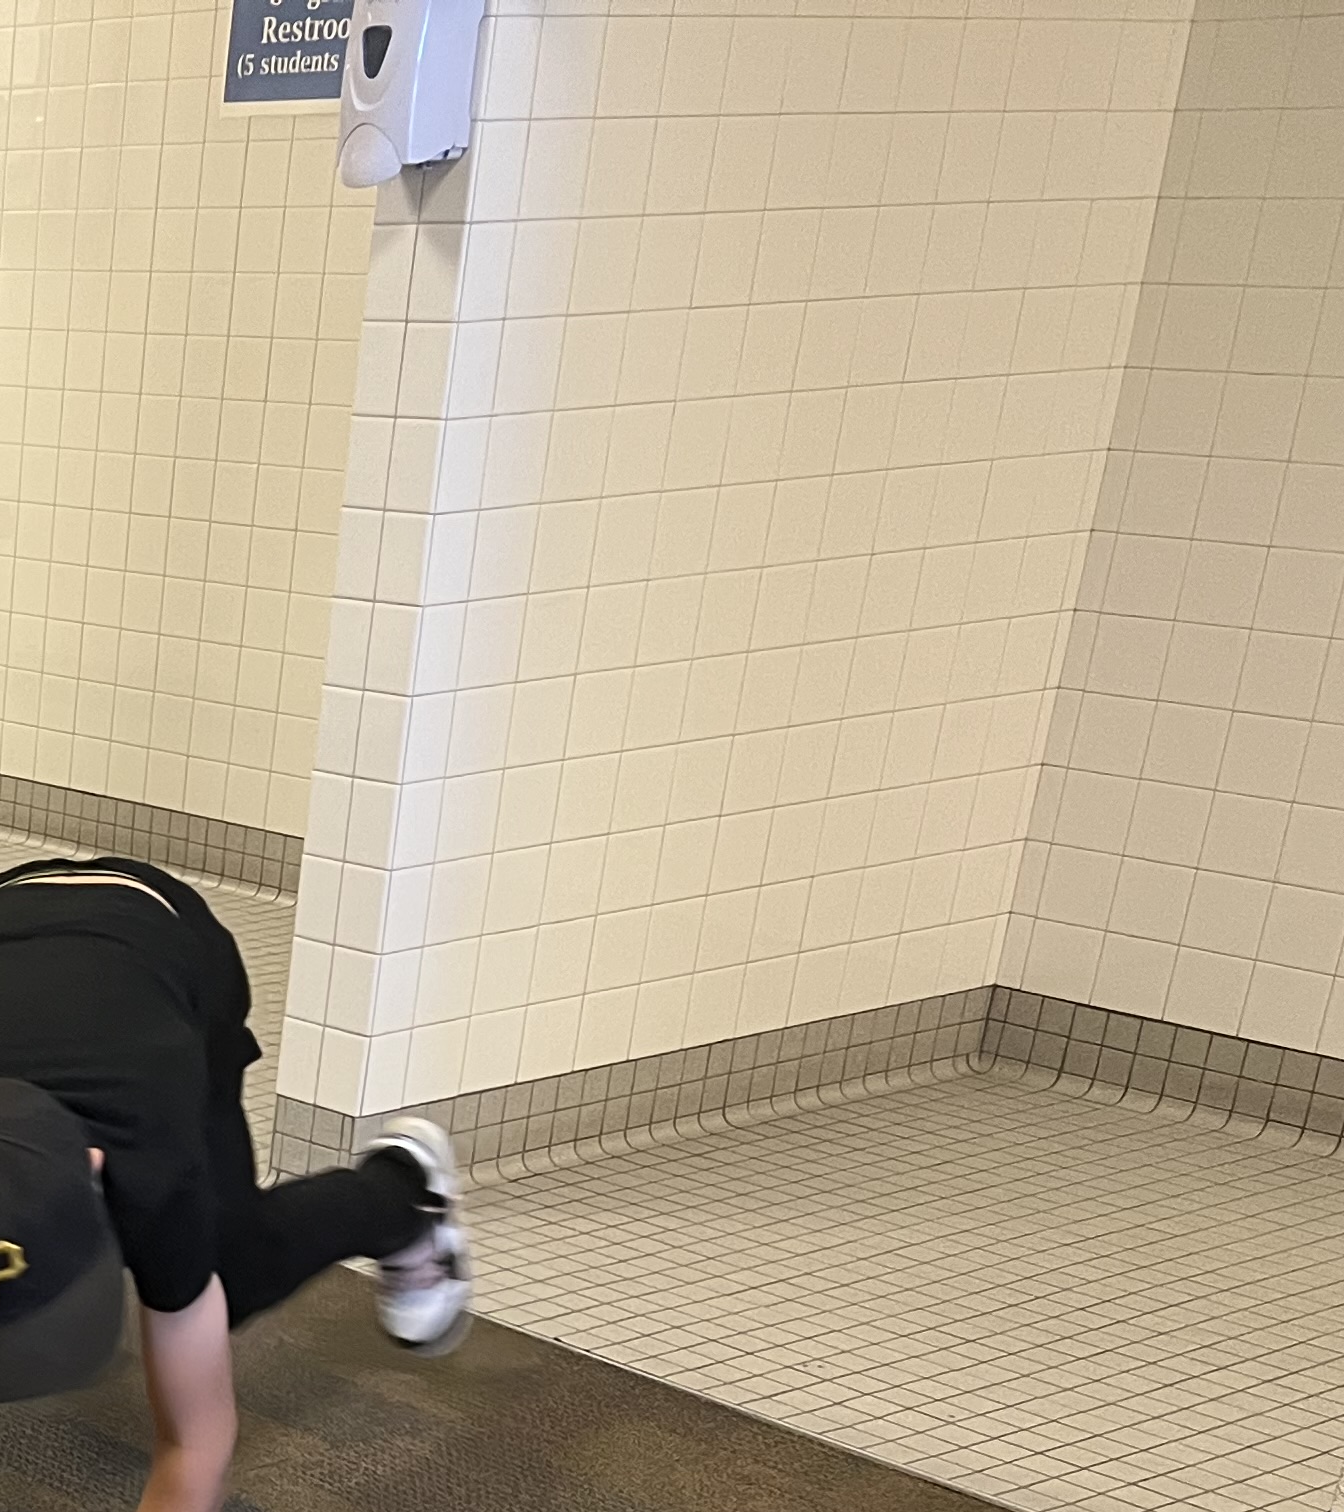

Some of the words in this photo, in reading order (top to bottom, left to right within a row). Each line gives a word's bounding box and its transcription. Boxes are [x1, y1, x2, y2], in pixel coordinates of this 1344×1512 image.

[261, 16, 351, 44] Restroo
[237, 53, 255, 78] (5
[259, 50, 340, 75] students
